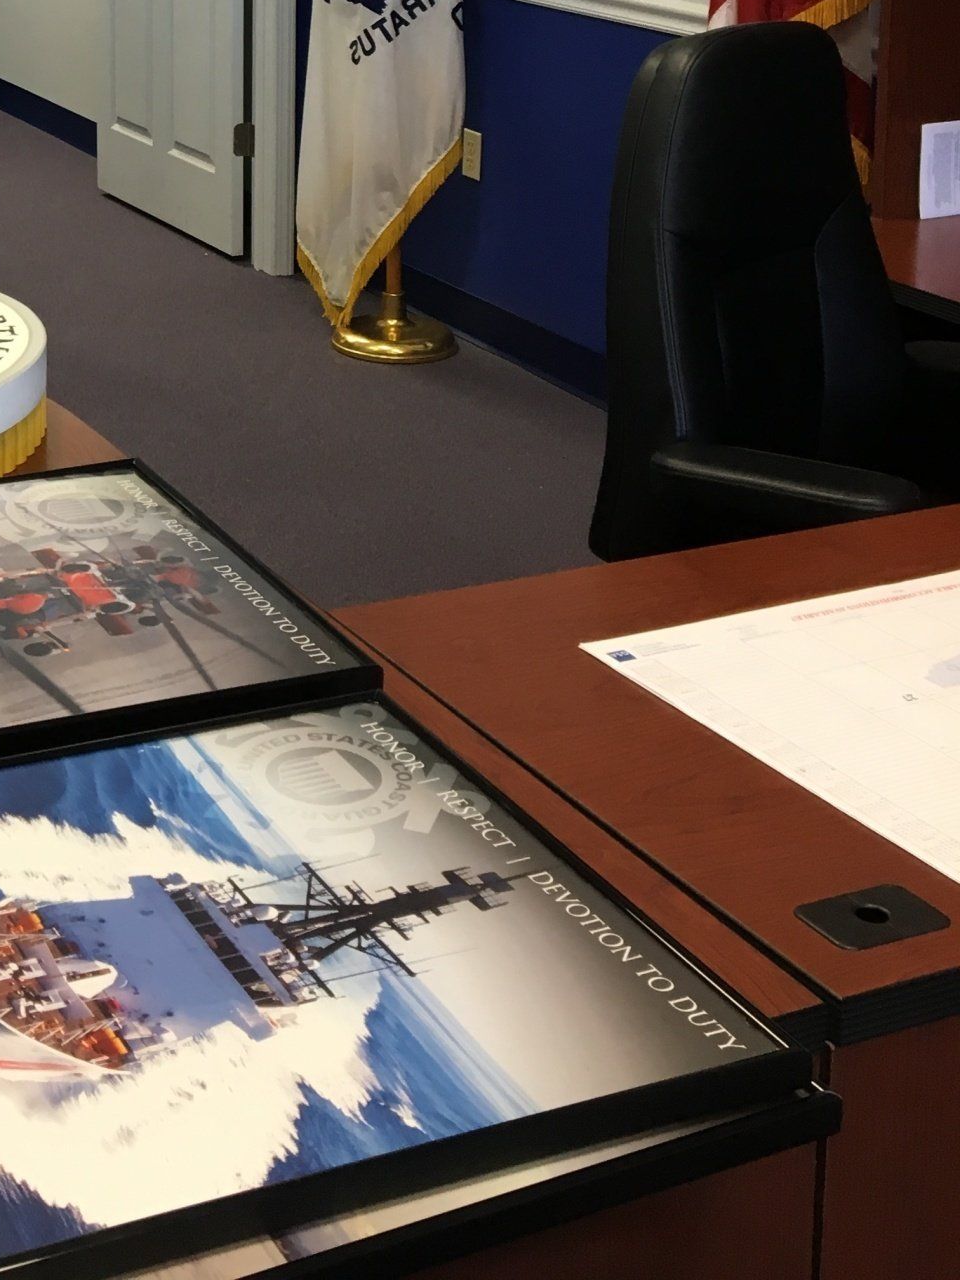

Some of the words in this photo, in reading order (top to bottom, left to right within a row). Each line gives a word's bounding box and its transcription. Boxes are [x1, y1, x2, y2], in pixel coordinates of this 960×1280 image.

[116, 478, 162, 510] HONOR
[162, 518, 212, 553] RESPECT
[214, 564, 281, 618] DEVOTION
[272, 616, 298, 634] TO
[290, 635, 337, 667] DUTY
[237, 733, 301, 773] UNITED
[307, 732, 392, 762] STATES
[382, 761, 413, 810] COAST
[360, 721, 425, 774] HONOR
[436, 789, 517, 850] RESPECT
[528, 871, 643, 962] DEVOTION
[636, 964, 675, 992] TO
[668, 996, 748, 1051] DUTY
